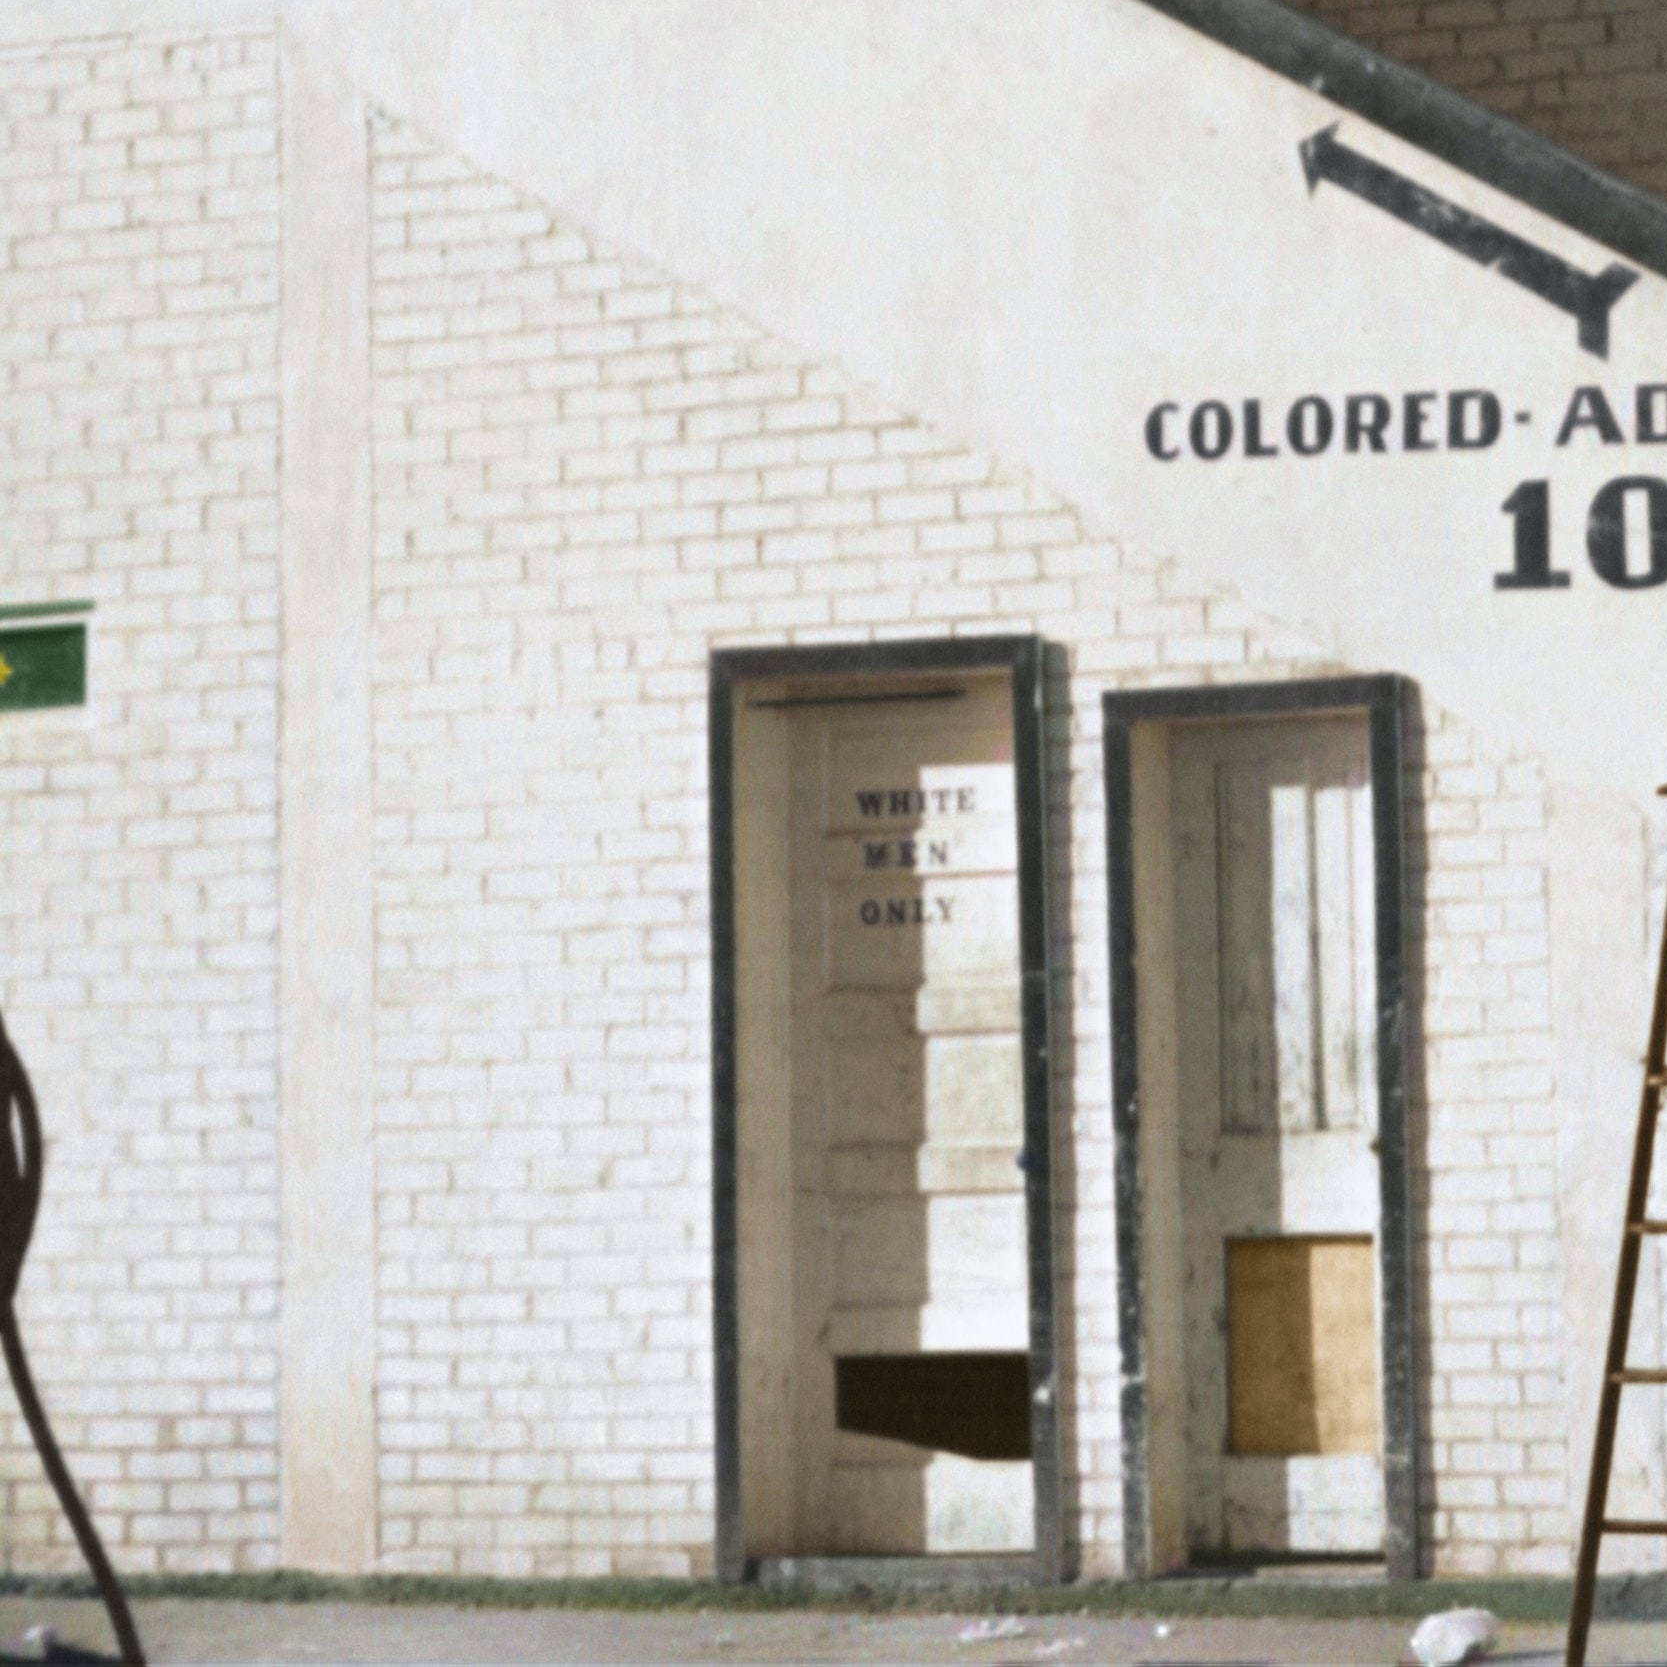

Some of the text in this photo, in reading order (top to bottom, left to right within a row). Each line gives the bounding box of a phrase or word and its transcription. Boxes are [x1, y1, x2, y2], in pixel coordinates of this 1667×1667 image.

[855, 787, 976, 817] WHITE
[863, 840, 948, 869] MEN
[859, 896, 955, 926] ONLY
